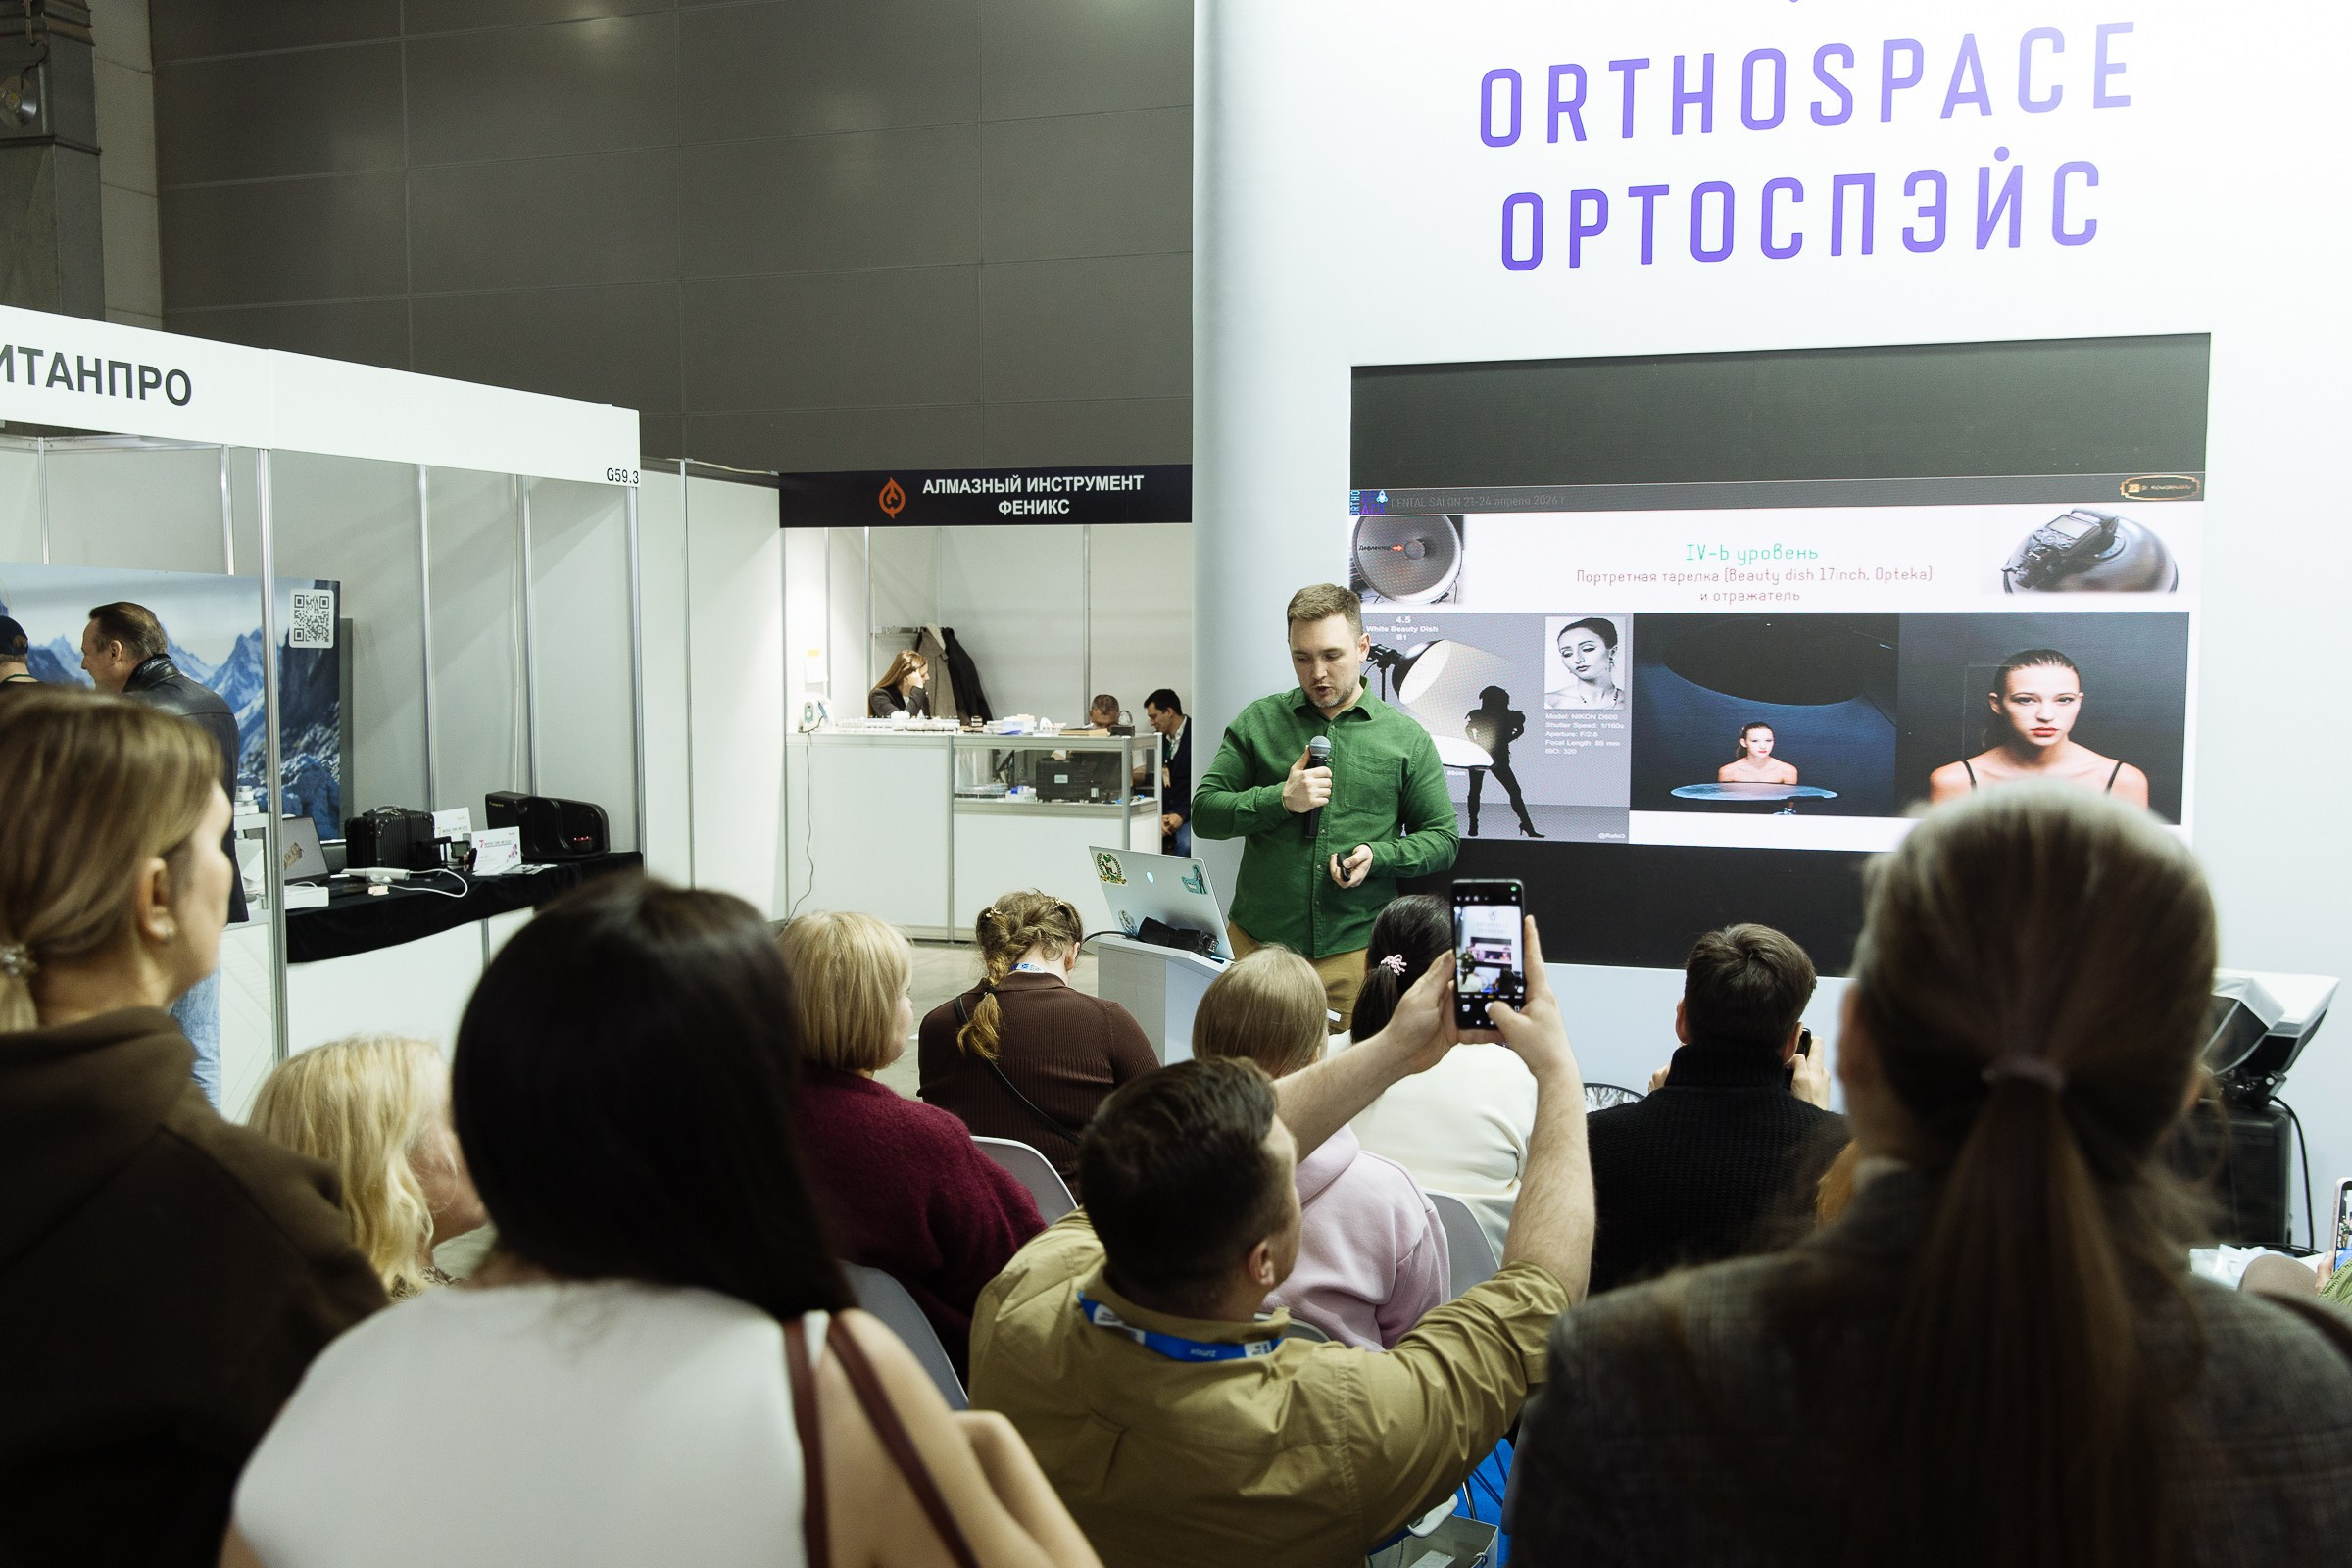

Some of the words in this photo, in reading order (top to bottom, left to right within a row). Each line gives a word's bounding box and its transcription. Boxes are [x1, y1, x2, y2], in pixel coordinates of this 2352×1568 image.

[1480, 21, 2134, 148] ORTHOSPACE
[1501, 145, 2099, 271] ОРТОСПЭЙС
[607, 467, 639, 484] G59.3
[922, 474, 1022, 494] АЛМАЗНЫЙ
[1027, 475, 1145, 493] ИНСТРУМЕНТ
[998, 499, 1070, 514] ФЕНИКС
[1391, 496, 1425, 508] DENTAL
[1429, 496, 1461, 507] SALON
[1464, 495, 1492, 507] 21-24
[1534, 494, 1558, 506] 2026
[1686, 543, 1730, 561] IV-b
[1738, 542, 1819, 566] уровень
[1577, 569, 1657, 586] Портретная
[1663, 572, 1719, 586] тарелка
[1785, 567, 1815, 581] dish
[1713, 591, 1801, 606] отражатель
[1390, 625, 1418, 634] Beauty
